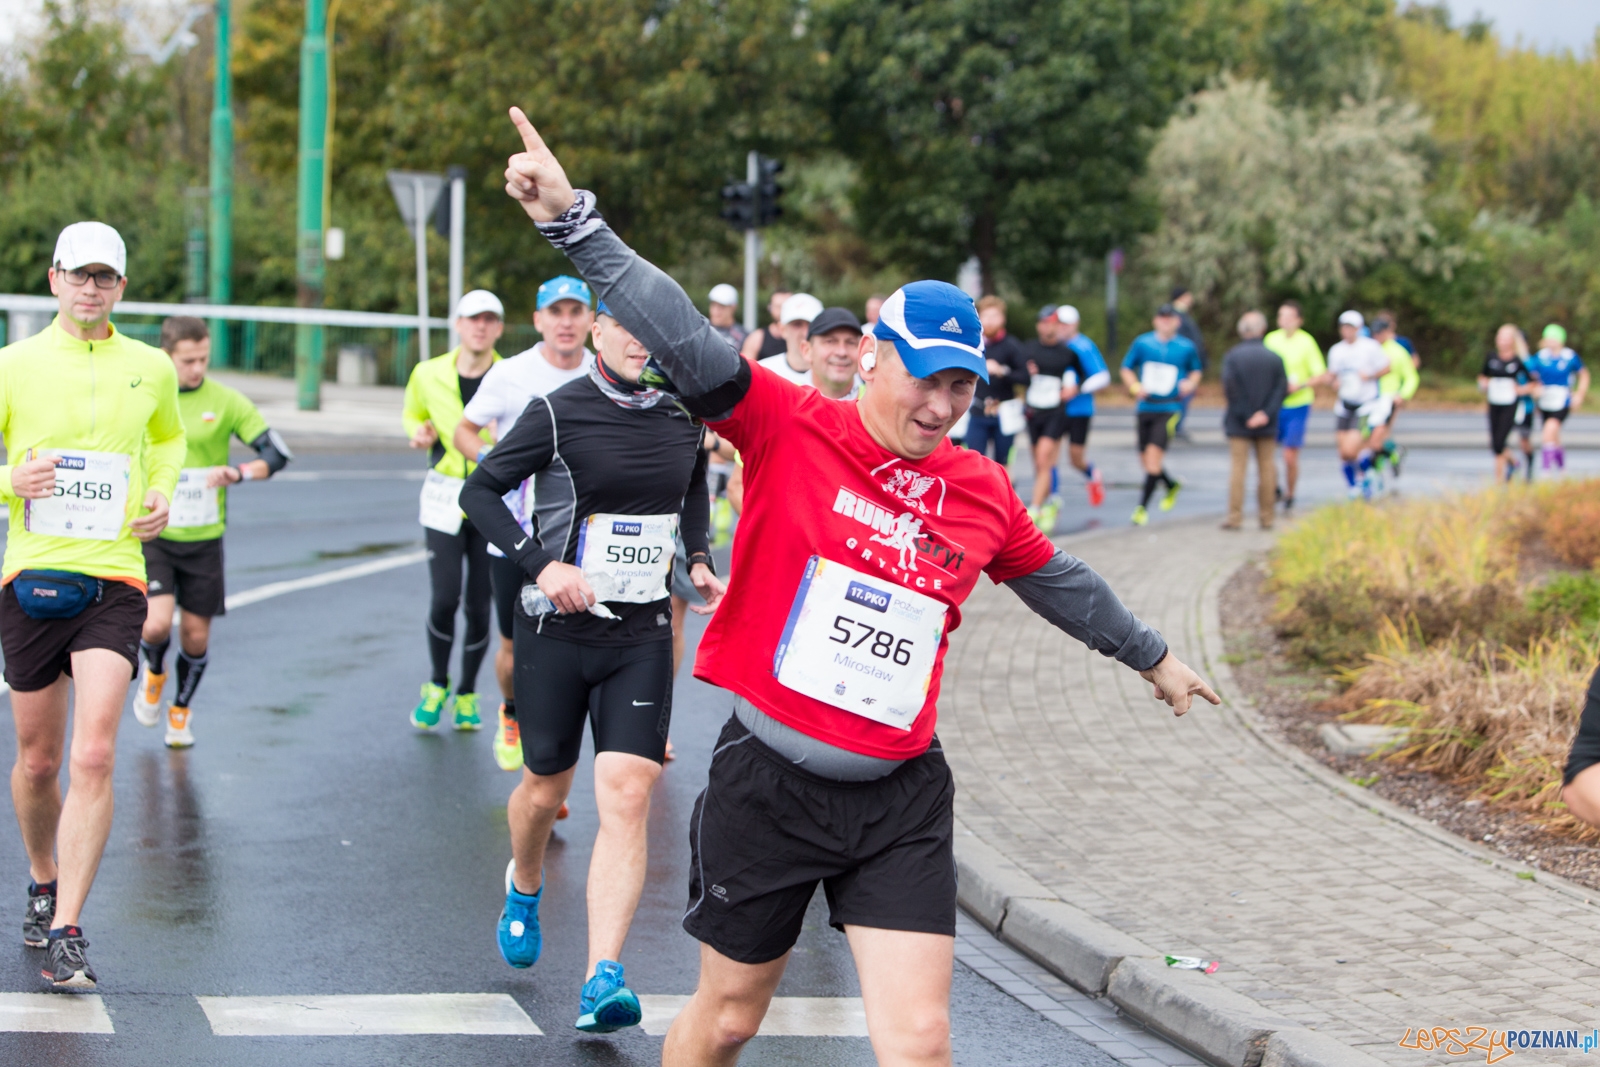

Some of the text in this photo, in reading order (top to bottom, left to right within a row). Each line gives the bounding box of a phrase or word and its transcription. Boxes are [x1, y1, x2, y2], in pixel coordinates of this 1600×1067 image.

[832, 488, 895, 536] RUN
[606, 545, 663, 564] 5902
[829, 615, 914, 666] 5786
[833, 652, 894, 682] Mirosław
